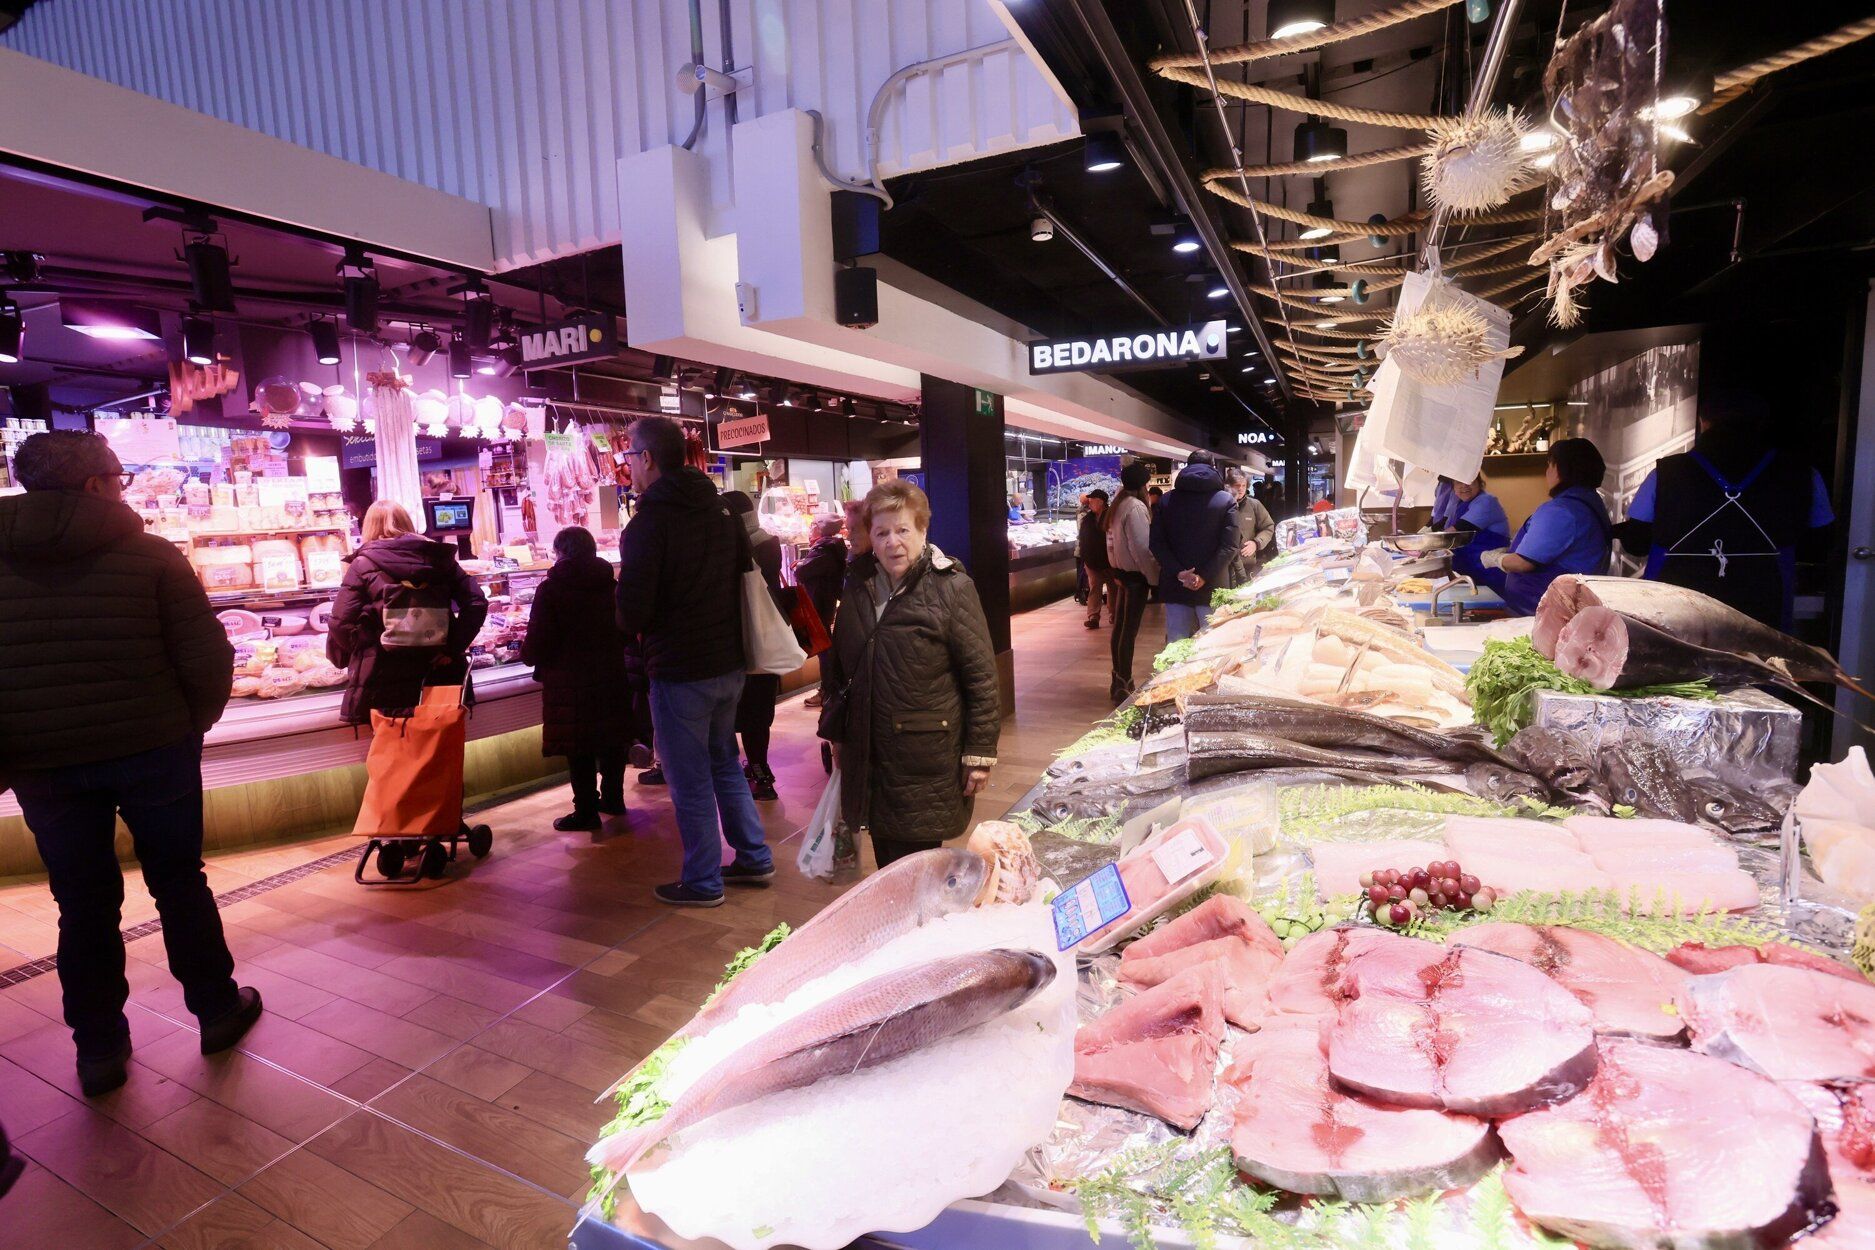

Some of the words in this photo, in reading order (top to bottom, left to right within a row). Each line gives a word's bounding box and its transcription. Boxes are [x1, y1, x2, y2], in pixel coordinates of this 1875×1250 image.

[521, 324, 588, 362] MARI
[1033, 330, 1202, 369] BEDARONA
[720, 422, 766, 441] PRECOCINADOS
[1238, 432, 1267, 444] NOA
